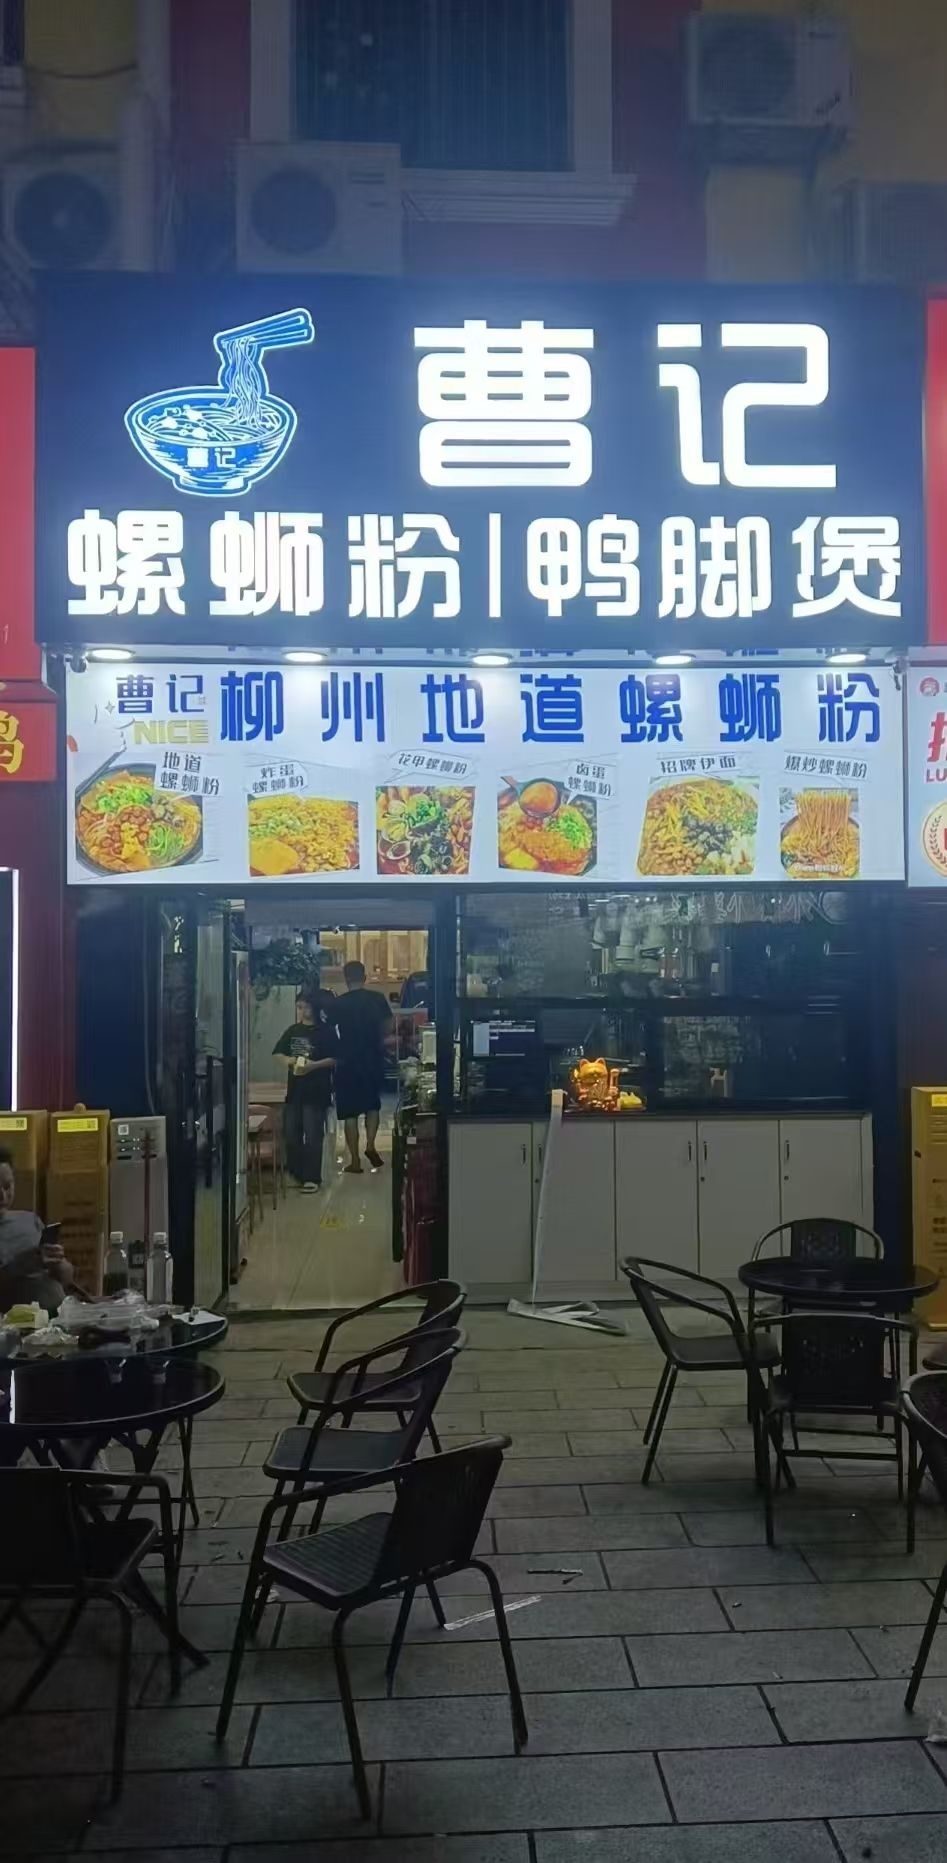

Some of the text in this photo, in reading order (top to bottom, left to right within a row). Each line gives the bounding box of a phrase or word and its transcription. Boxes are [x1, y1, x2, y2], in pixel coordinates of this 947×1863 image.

[414, 319, 836, 488] 曹记
[116, 674, 205, 714] 曹记
[220, 670, 881, 743] 柳州地道螺蛳粉
[133, 719, 209, 745] NICE
[162, 751, 201, 774] 地道
[398, 753, 468, 775] 花甲螺蛳粉
[660, 755, 737, 774] 招牌伊面
[784, 755, 868, 779] 爆炒螺蛳粉
[160, 771, 220, 796] 螺蛳粉
